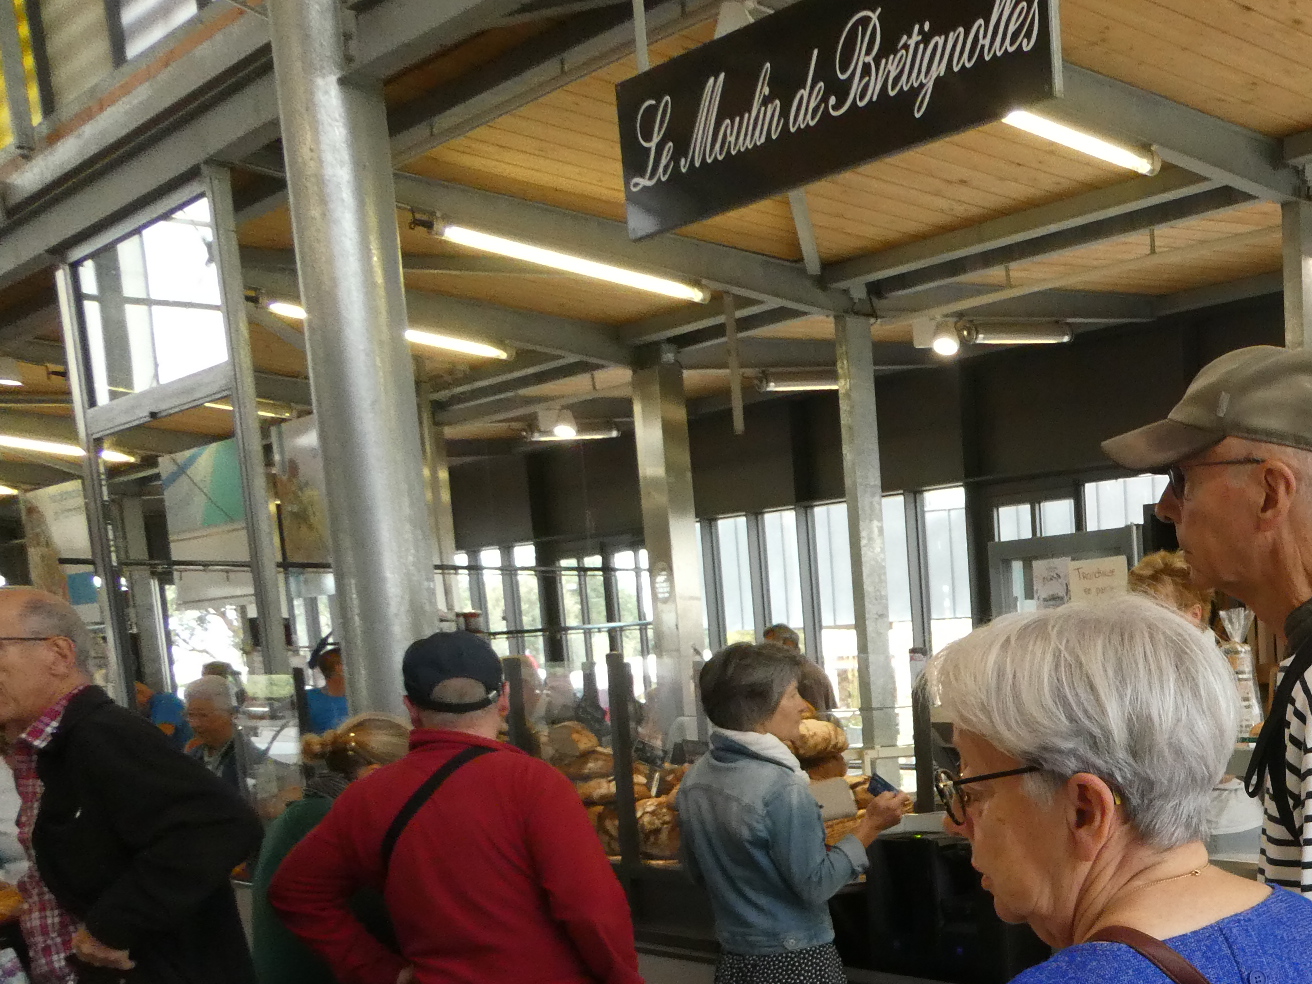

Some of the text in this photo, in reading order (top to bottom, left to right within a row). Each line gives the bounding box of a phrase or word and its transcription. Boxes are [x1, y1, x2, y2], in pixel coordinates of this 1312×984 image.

[630, 0, 1039, 192] Le Moulin de Brétignolles
